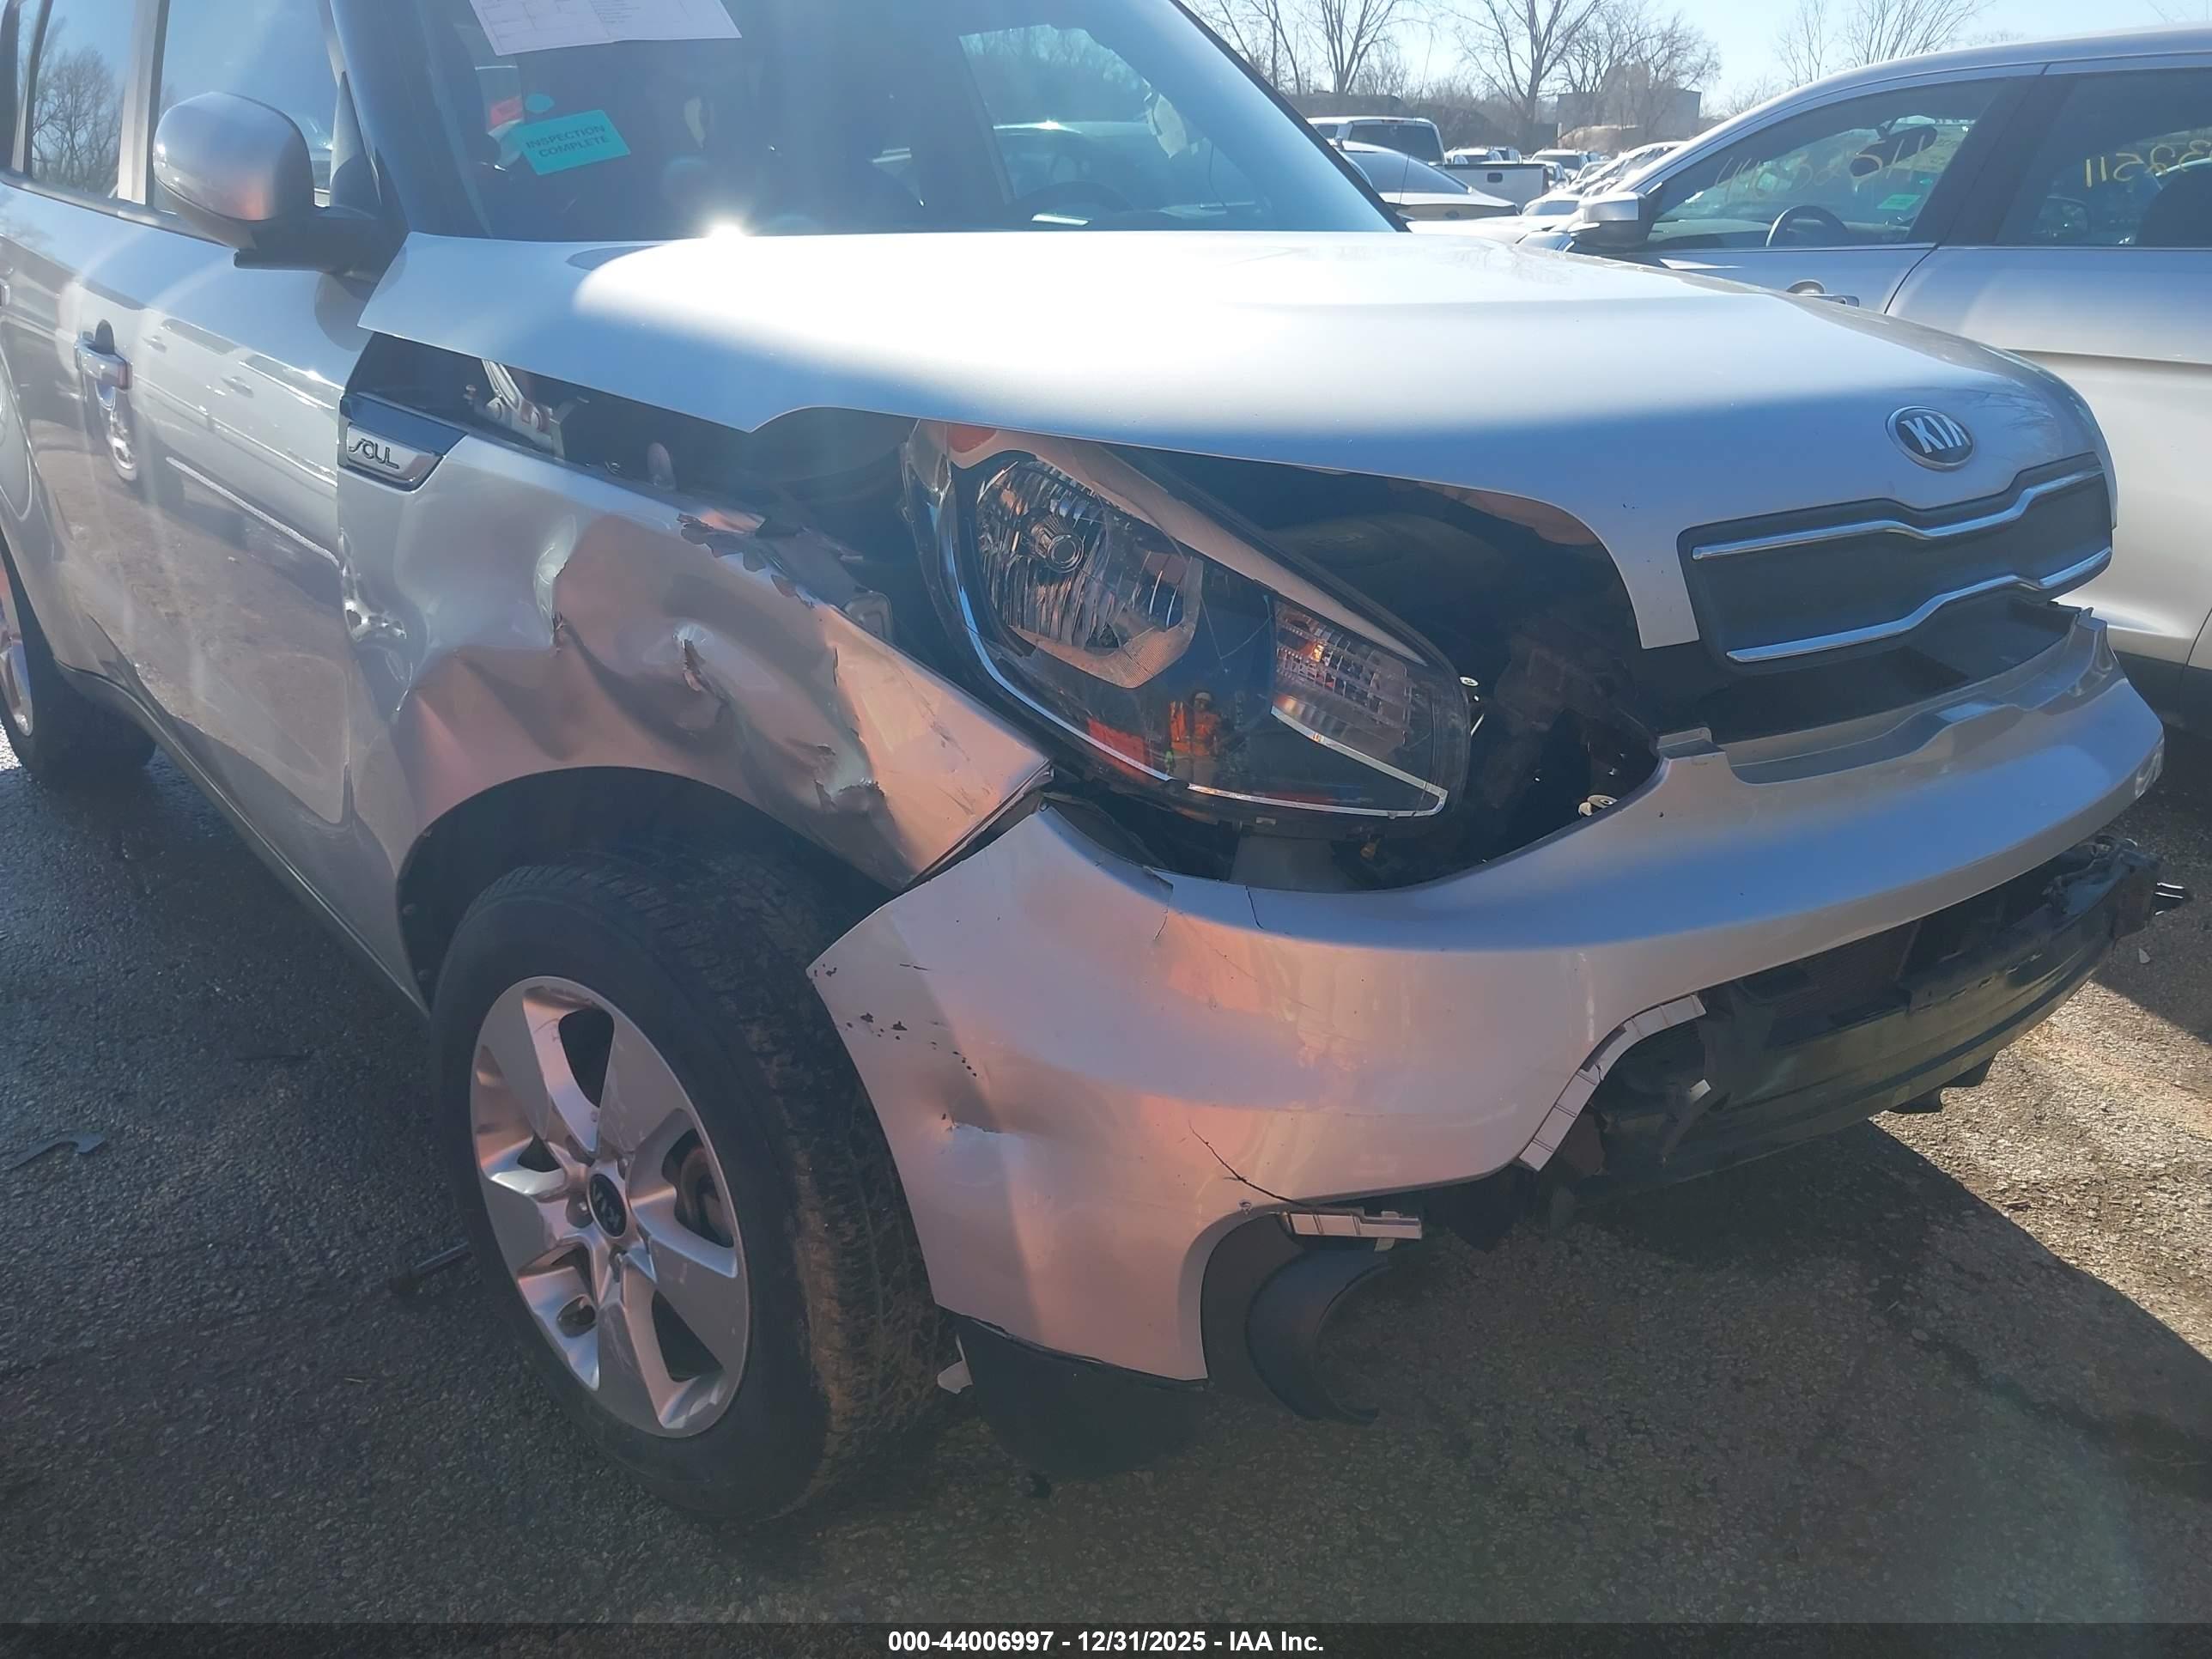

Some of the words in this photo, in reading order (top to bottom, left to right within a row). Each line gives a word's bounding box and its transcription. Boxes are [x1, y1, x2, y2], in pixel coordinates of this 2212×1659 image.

[526, 124, 606, 150] INSPECTION
[538, 134, 610, 158] COMPLETE
[1899, 414, 1972, 454] KIA
[348, 438, 400, 471] SOUL
